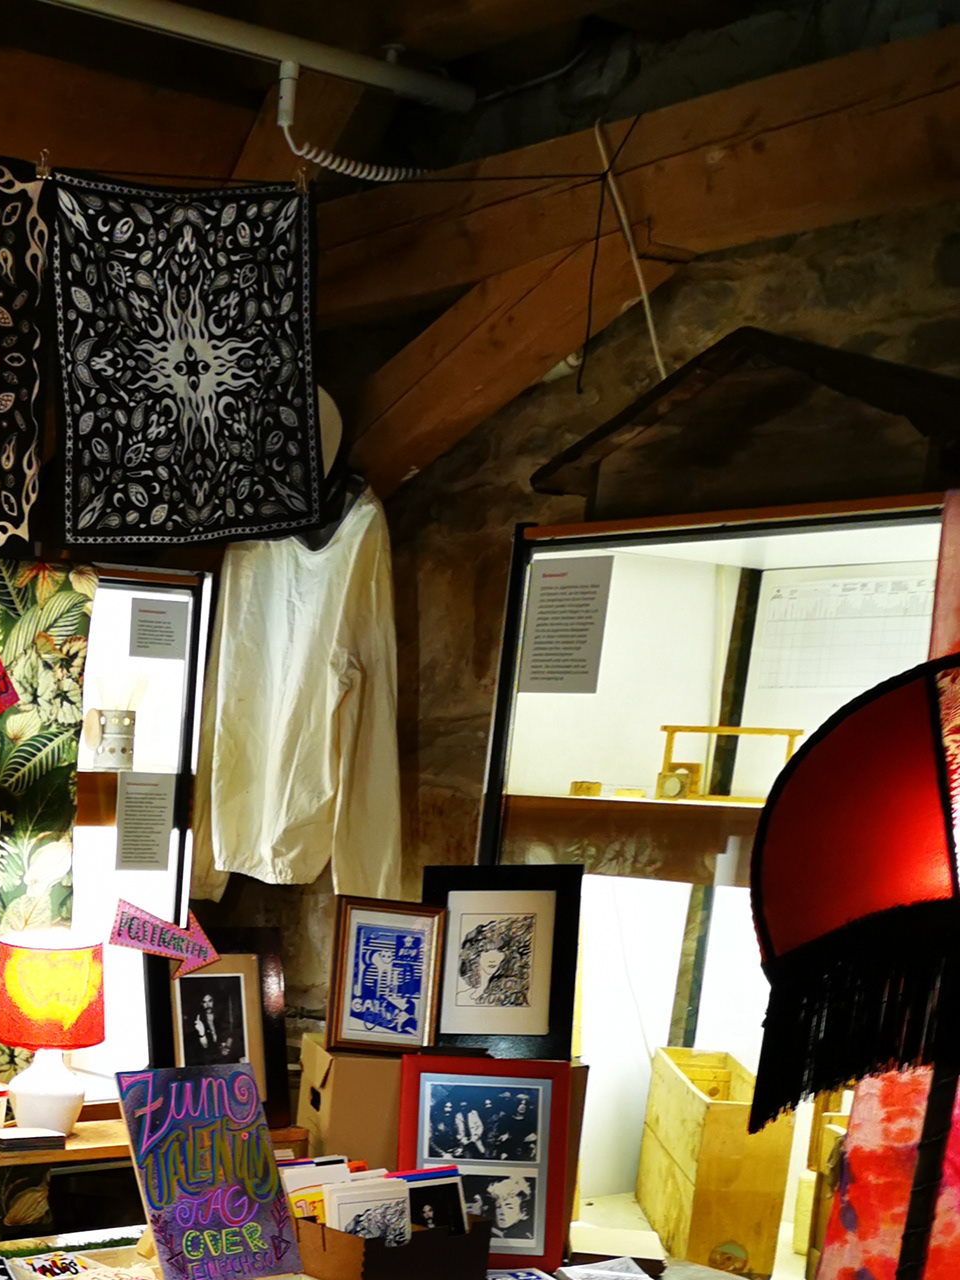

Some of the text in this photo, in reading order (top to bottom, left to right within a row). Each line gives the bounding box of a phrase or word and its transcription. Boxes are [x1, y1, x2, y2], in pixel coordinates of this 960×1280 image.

[117, 911, 209, 962] POSTKARTEN
[175, 1185, 258, 1228] TAG
[182, 1222, 268, 1260] ODER
